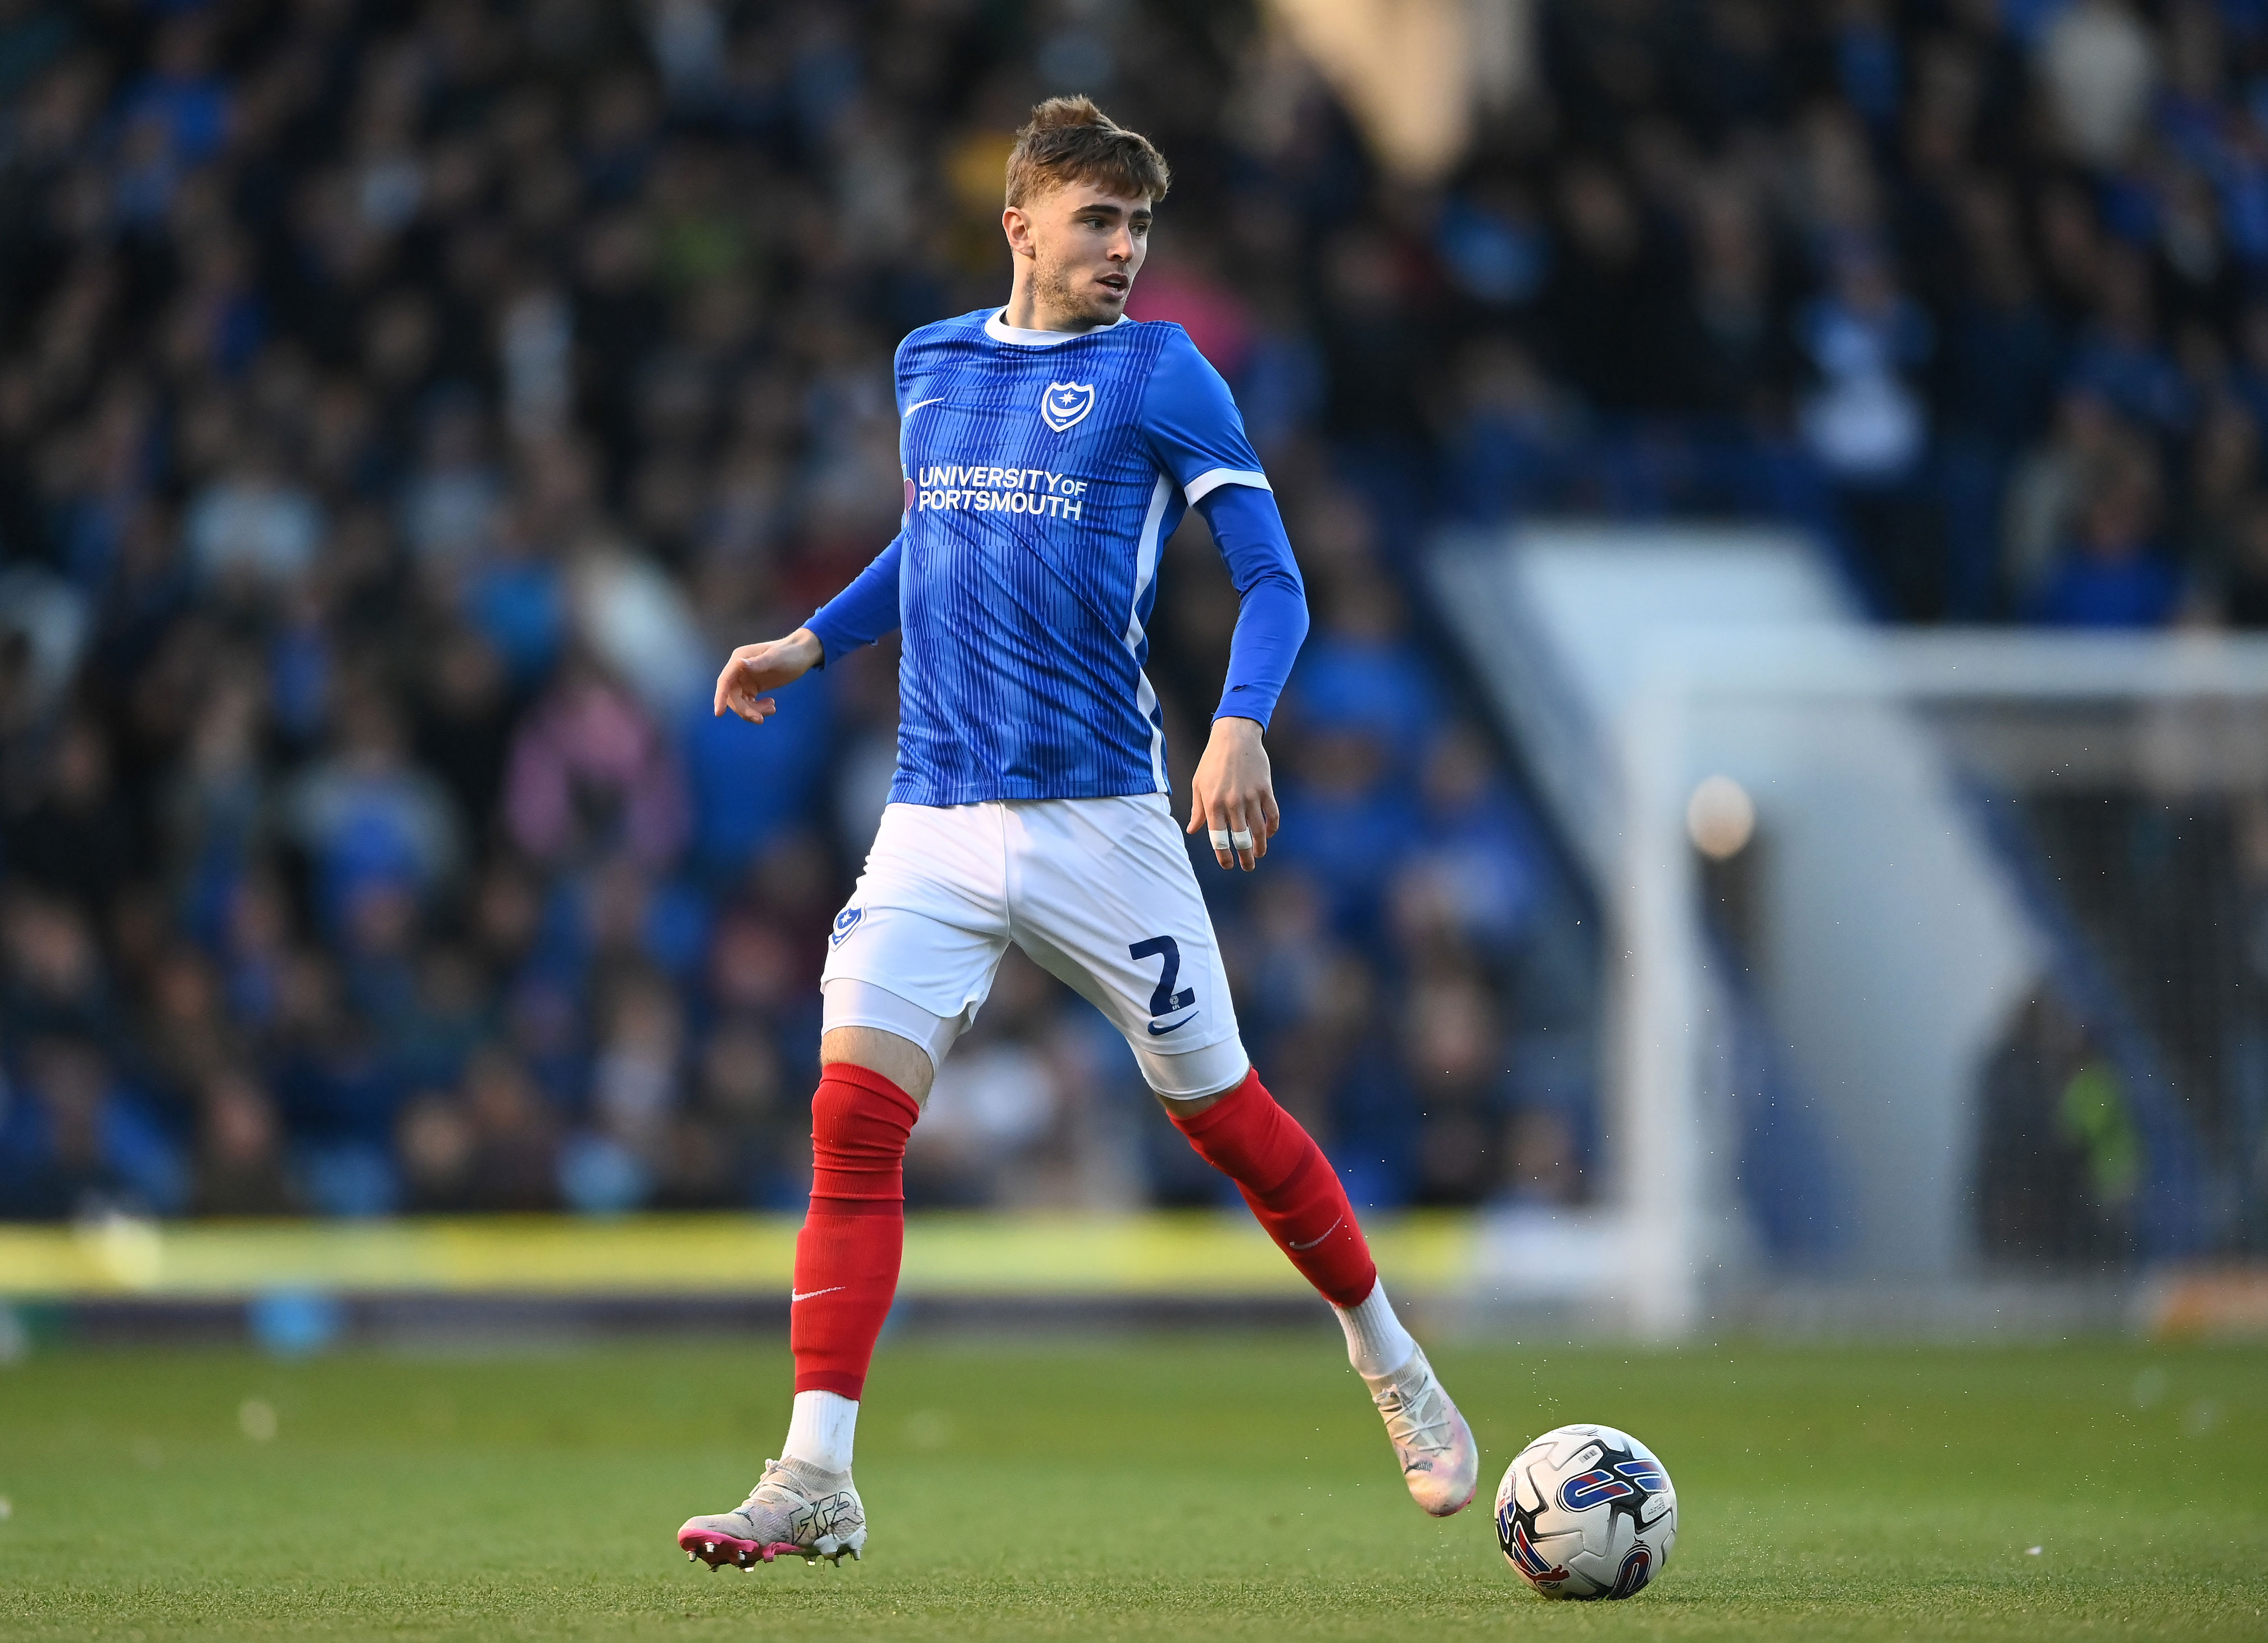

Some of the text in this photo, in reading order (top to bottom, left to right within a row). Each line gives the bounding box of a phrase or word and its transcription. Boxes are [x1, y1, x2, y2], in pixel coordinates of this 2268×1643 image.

[919, 466, 1087, 496] UNIVERSITY OF
[919, 490, 1082, 521] PORTSMOUTH
[1128, 935, 1195, 1017] 2
